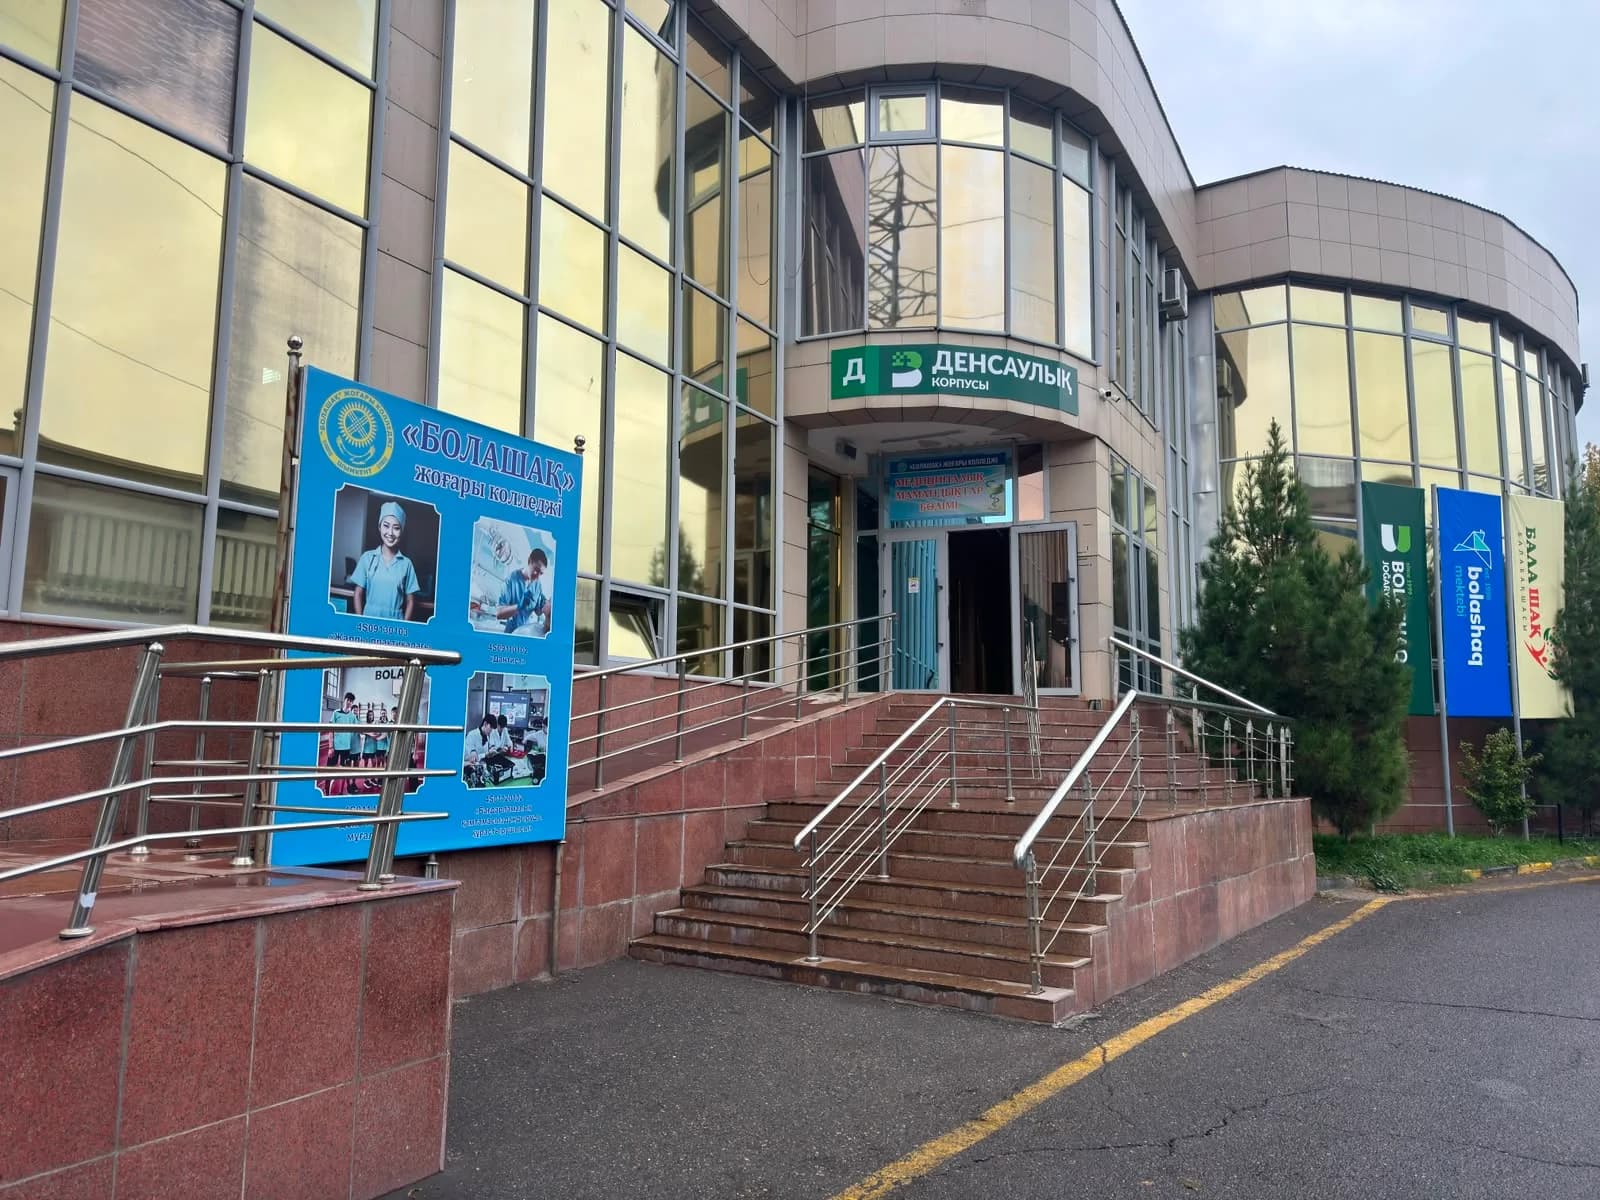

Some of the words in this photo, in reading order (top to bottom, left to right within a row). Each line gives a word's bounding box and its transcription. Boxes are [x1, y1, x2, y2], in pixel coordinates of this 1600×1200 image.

[842, 357, 866, 386] Д
[931, 350, 1073, 395] ДЕНСАУЛЫҚ
[931, 376, 989, 391] КОРПУСЫ
[402, 419, 575, 497] «БОЛАШАҚ»
[414, 464, 485, 499] жоғары
[488, 484, 563, 518] колледжі
[919, 501, 958, 512] БӨЛІМІ
[1525, 526, 1538, 584] БАЛА
[1456, 565, 1467, 617] mektebi
[1468, 566, 1486, 666] bolashaq
[375, 668, 404, 680] BOLA
[346, 831, 373, 843] мұғал
